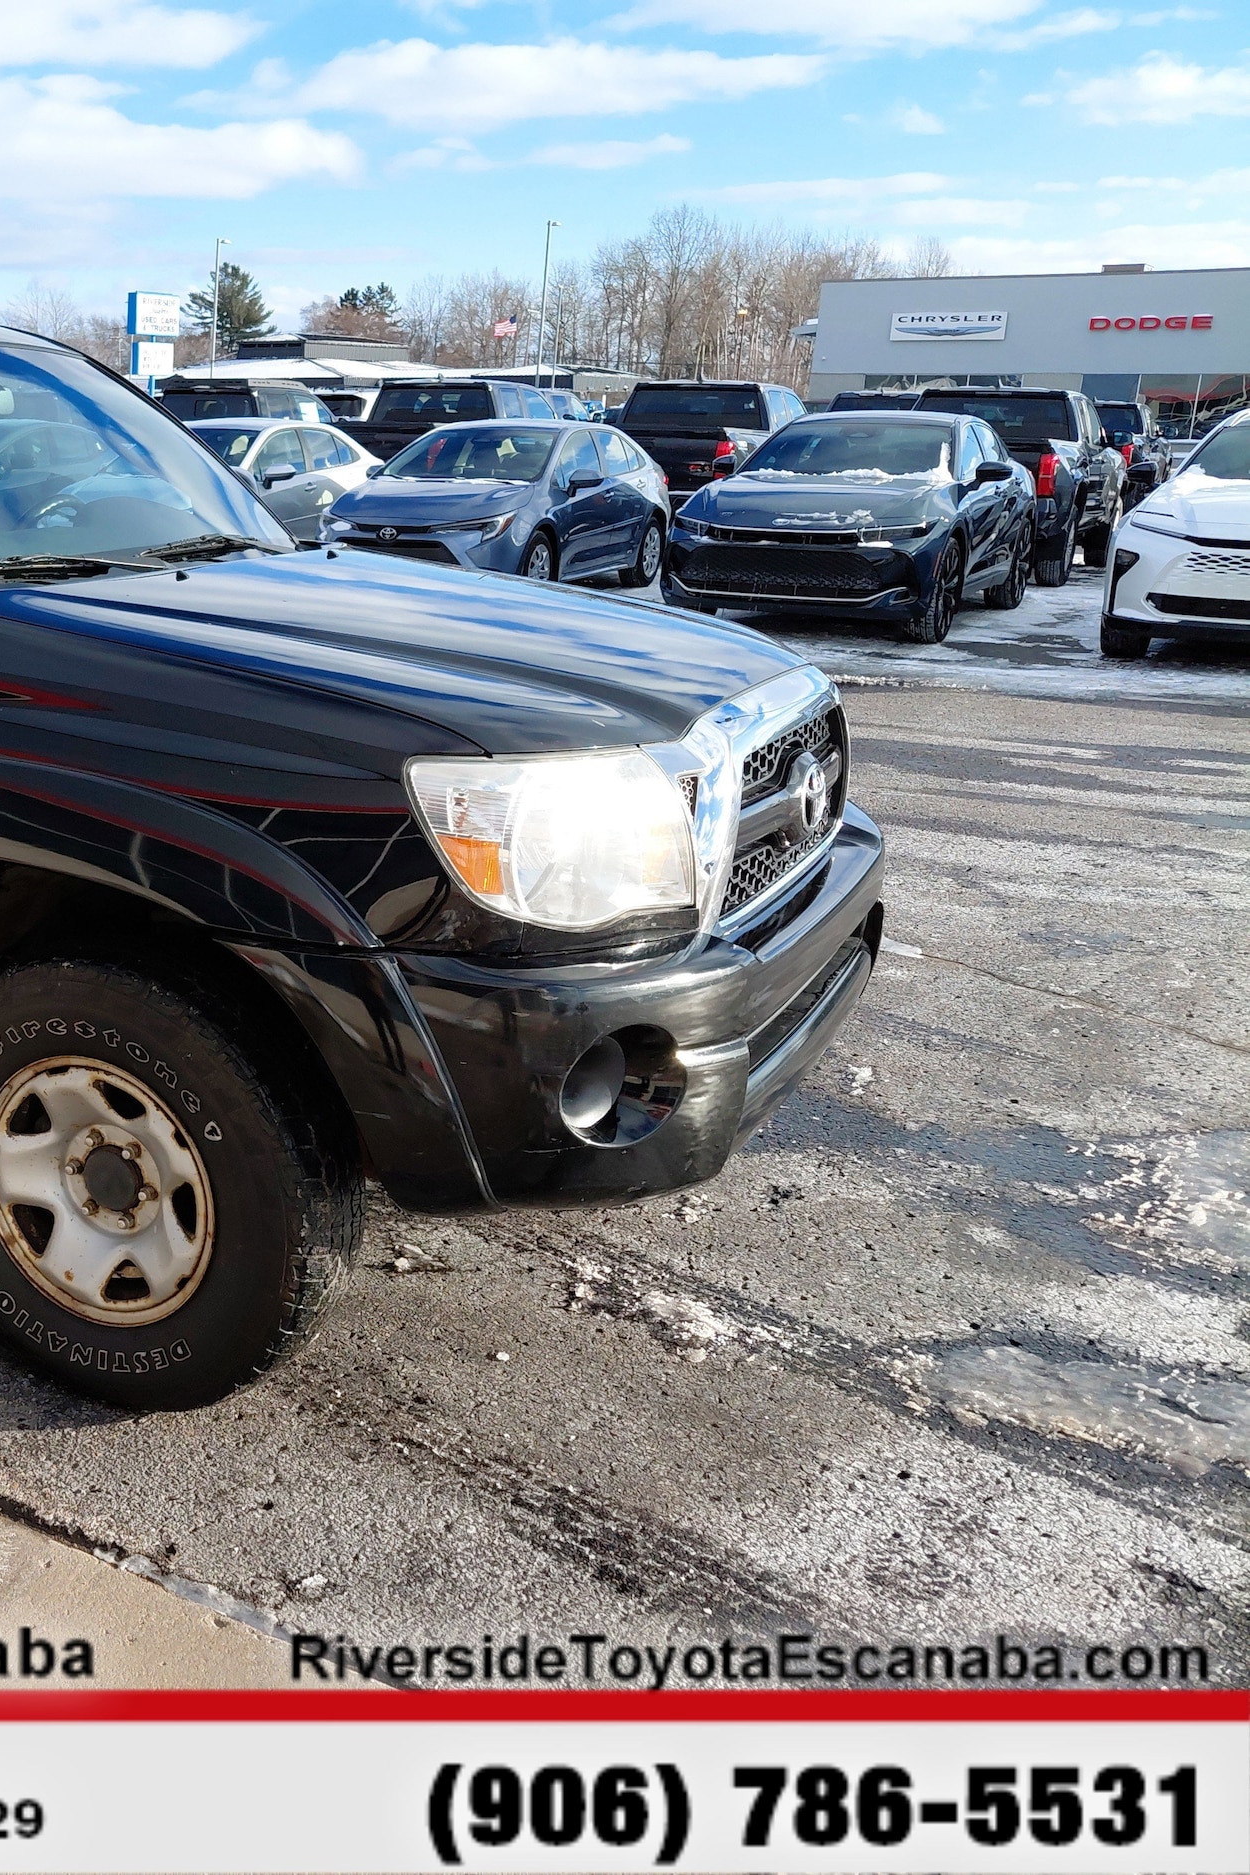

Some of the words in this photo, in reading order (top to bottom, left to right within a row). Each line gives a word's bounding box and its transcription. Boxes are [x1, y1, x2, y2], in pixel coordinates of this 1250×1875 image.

[161, 317, 177, 325] CARS
[897, 314, 1003, 323] CHRYSLER
[1089, 315, 1213, 331] DODGE
